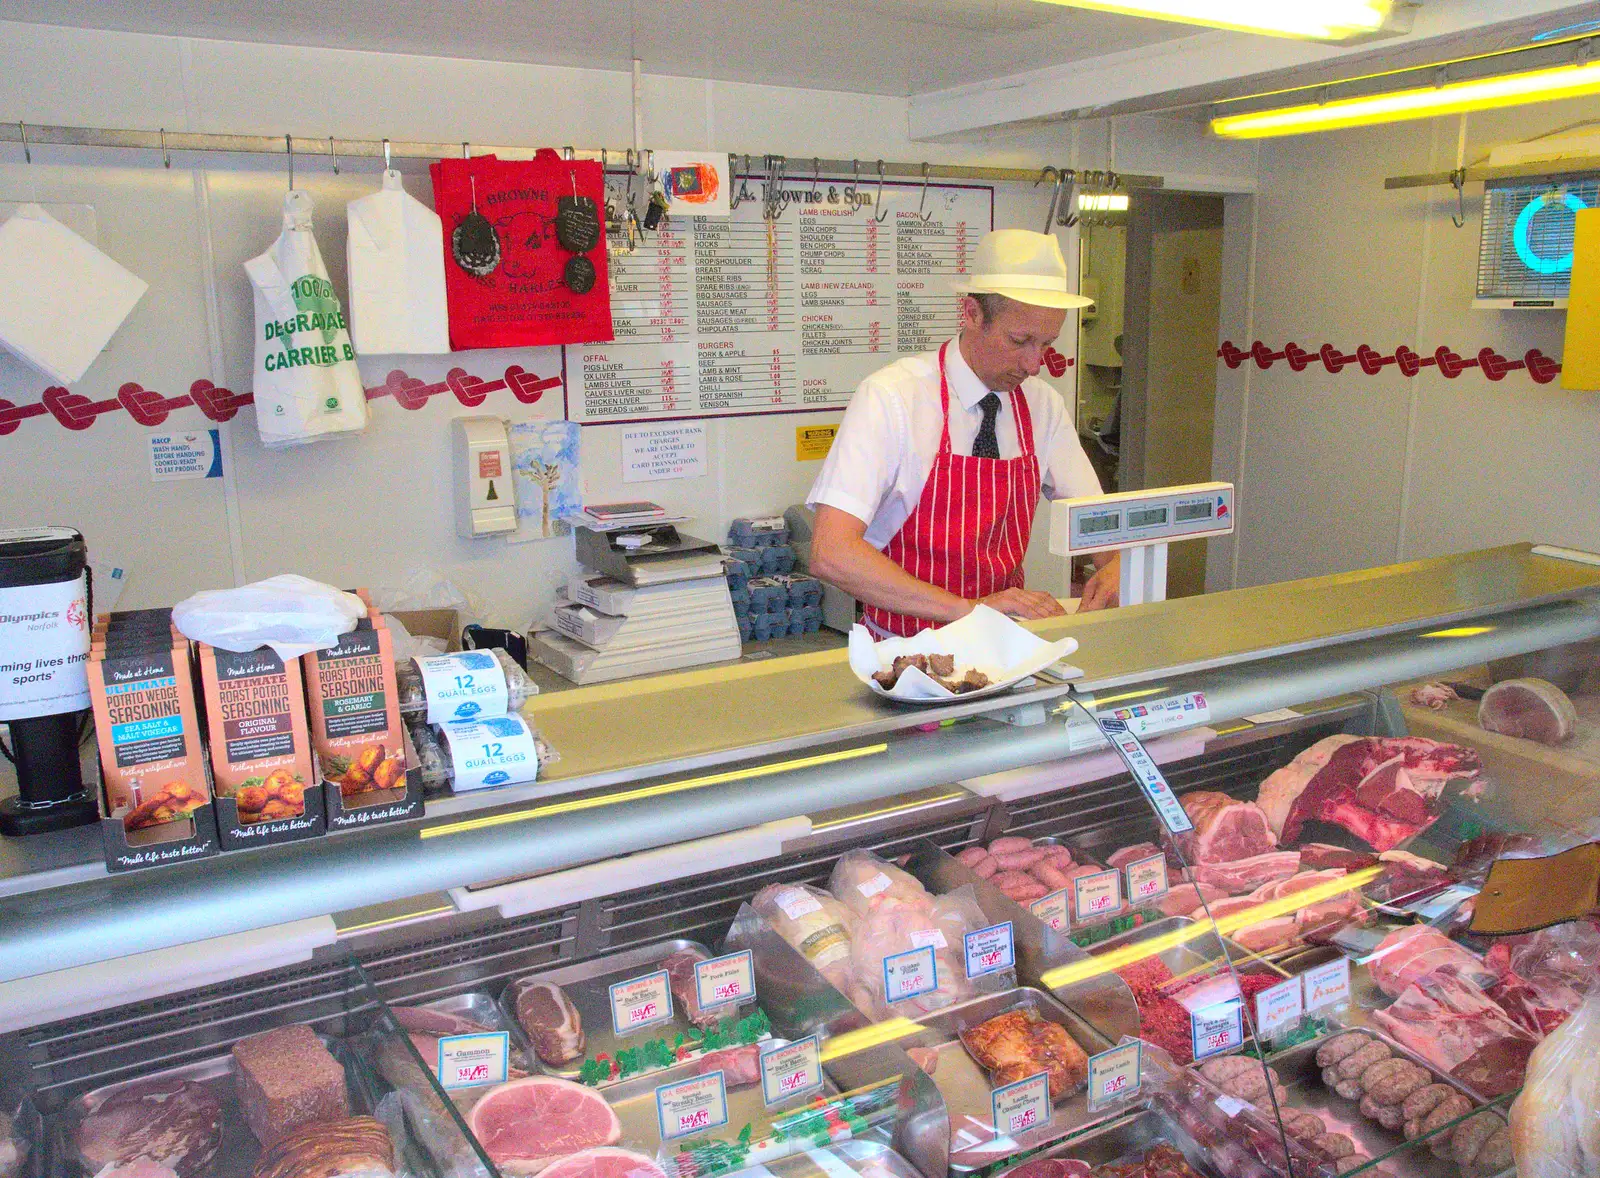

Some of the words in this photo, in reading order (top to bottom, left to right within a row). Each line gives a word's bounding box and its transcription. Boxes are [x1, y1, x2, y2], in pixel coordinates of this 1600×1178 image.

[486, 189, 548, 205] BROWNE
[827, 186, 839, 205] &
[844, 186, 872, 206] Son
[820, 209, 854, 217] (ENGLISH)
[265, 346, 338, 371] CARRIER
[342, 344, 354, 360] B
[650, 428, 683, 437] EXCESSIVE
[652, 457, 698, 467] TRANSACTIONS
[0, 611, 59, 624] Olympics
[28, 621, 59, 631] Norfolk
[327, 648, 343, 657] Made
[344, 646, 352, 655] at
[353, 645, 370, 653] Home
[35, 655, 64, 668] lives
[318, 655, 380, 670] ULTIMATE
[114, 671, 133, 680] Made
[134, 668, 142, 676] at
[144, 666, 164, 675] Home
[227, 668, 245, 676] Made
[247, 665, 254, 673] at
[256, 664, 275, 672] Home
[320, 668, 347, 683] ROAST
[350, 663, 383, 679] POTATO
[105, 677, 176, 695] ULTIMATE
[219, 675, 287, 690] ULTIMATE
[321, 677, 384, 698] SEASONING
[455, 675, 475, 689] 12
[107, 692, 143, 708] POTATO
[146, 687, 178, 702] WEDGE
[220, 688, 250, 703] ROAST
[252, 684, 288, 699] POTATO
[438, 689, 467, 698] QUAIL
[472, 685, 496, 694] EGGS
[334, 695, 373, 707] ROSEMARY
[345, 703, 371, 712] GARLIC
[109, 699, 181, 724] SEASONING
[221, 697, 290, 720] SEASONING
[124, 724, 140, 732] SEA
[142, 721, 161, 730] SALT
[239, 717, 277, 728] ORIGINAL
[118, 732, 140, 741] MALT
[142, 726, 177, 737] VINEGAR
[240, 724, 276, 735] FLAVOUR
[482, 743, 503, 757] 12
[466, 758, 495, 768] QUAIL
[500, 754, 525, 763] EGGS
[357, 814, 370, 824] life
[371, 811, 388, 820] taste
[256, 825, 269, 836] life
[270, 823, 290, 832] taste
[145, 852, 159, 863] life
[160, 849, 180, 858] taste
[972, 949, 993, 957] Chicken
[456, 1048, 490, 1056] Gammon
[672, 1098, 694, 1108] Streaky
